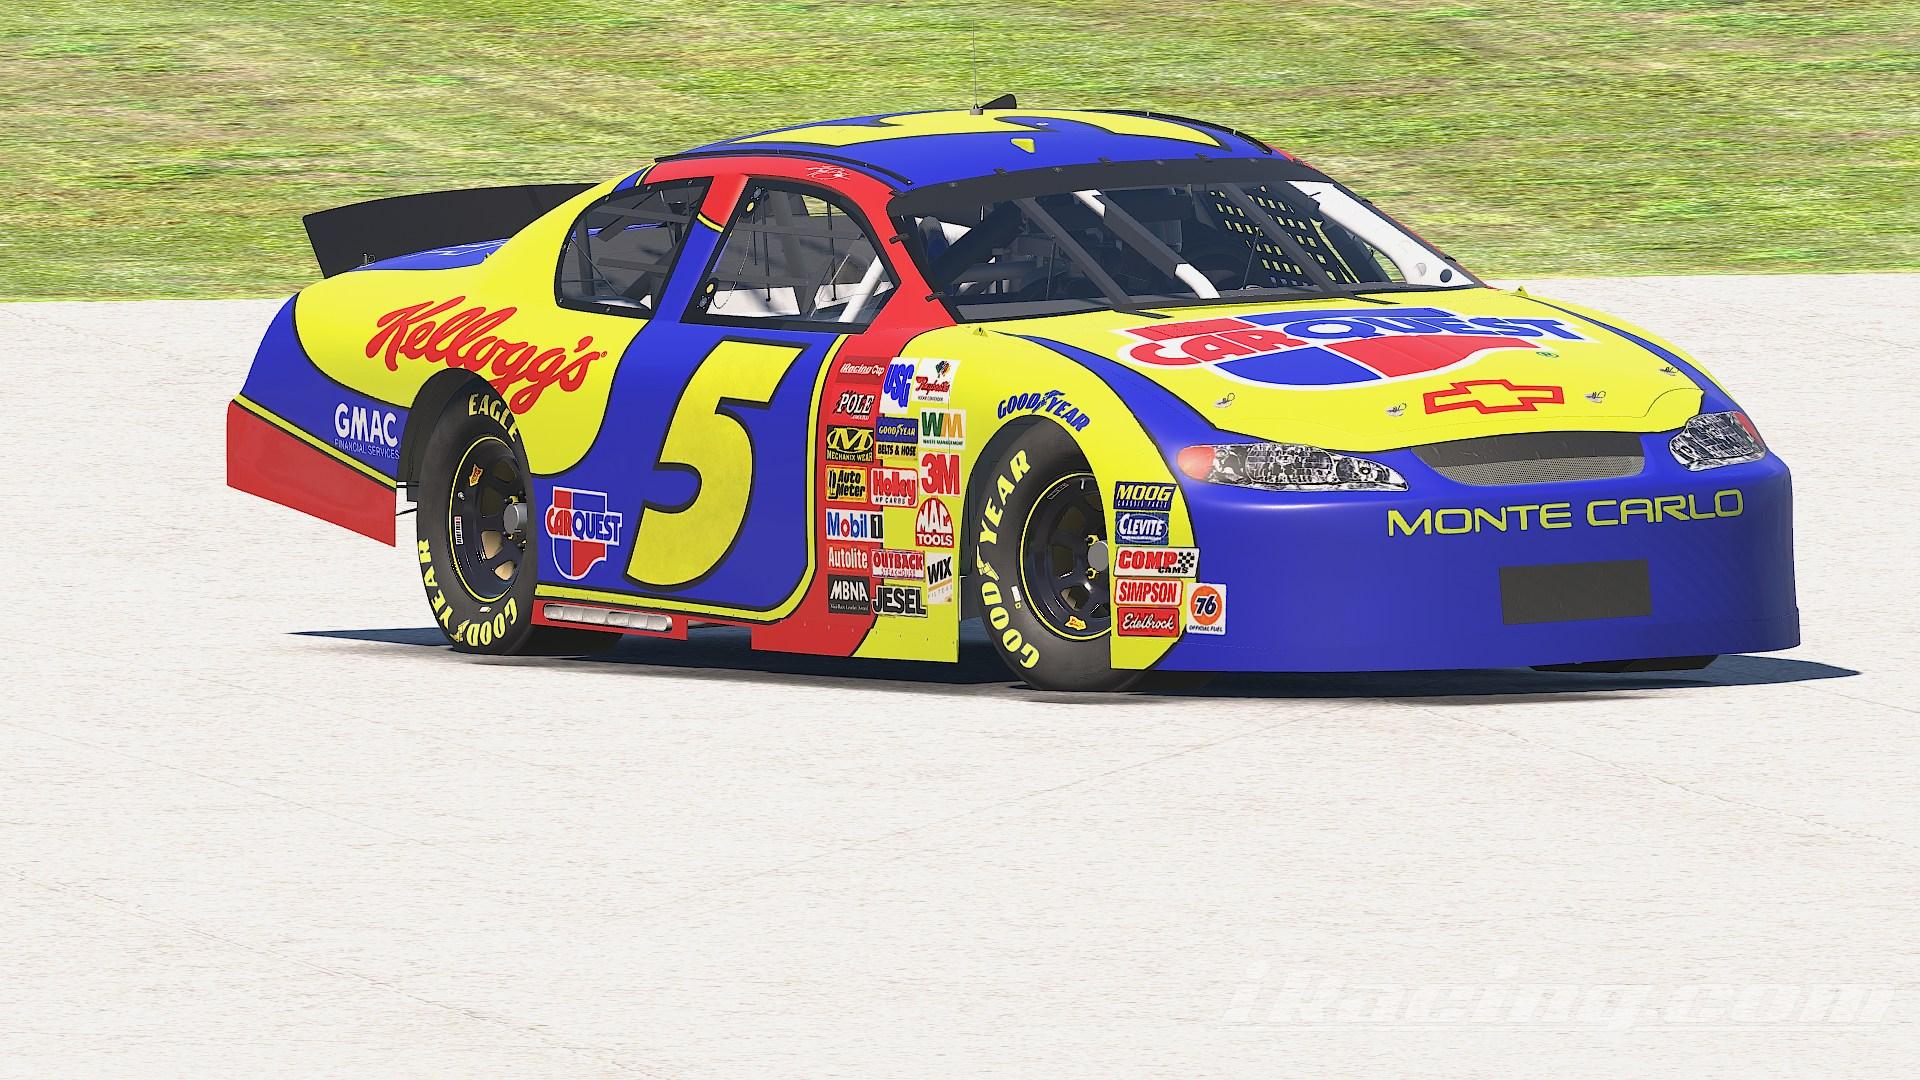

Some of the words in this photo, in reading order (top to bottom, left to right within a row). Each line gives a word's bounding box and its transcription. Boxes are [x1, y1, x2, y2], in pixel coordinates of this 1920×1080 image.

[1129, 317, 1585, 366] CARQUEST
[366, 296, 600, 414] Kellogg's
[883, 363, 914, 408] USG
[837, 393, 875, 414] POLE
[335, 403, 398, 448] GMAC
[469, 393, 519, 441] EAGLE
[921, 411, 963, 438] WM
[335, 438, 367, 454] FINANCIAL
[367, 444, 400, 460] SERVICES
[827, 450, 856, 460] MECHANIX
[857, 452, 873, 461] WEAR
[878, 444, 893, 455] BELTS
[895, 446, 900, 455] &
[901, 446, 916, 456] HOSE
[626, 338, 806, 587] 5
[838, 470, 861, 483] Auto
[921, 453, 960, 495] 3M
[837, 484, 865, 497] Meter
[873, 470, 916, 505] Holley
[1116, 484, 1171, 501] MOOG
[1387, 502, 1572, 537] MONTE
[1586, 489, 1744, 527] CARLO
[546, 506, 621, 544] CARQUEST
[827, 512, 868, 538] Mobil
[917, 534, 953, 546] TOOLS
[828, 546, 868, 569] Autolite
[873, 552, 923, 571] OUTBACK
[1118, 550, 1178, 569] COMP
[927, 557, 952, 584] WIX
[830, 580, 869, 601] MBNA
[872, 587, 926, 615] JESEL
[1119, 581, 1177, 602] SIMPSON
[1195, 595, 1217, 616] 76
[1122, 613, 1175, 631] Edelbrock
